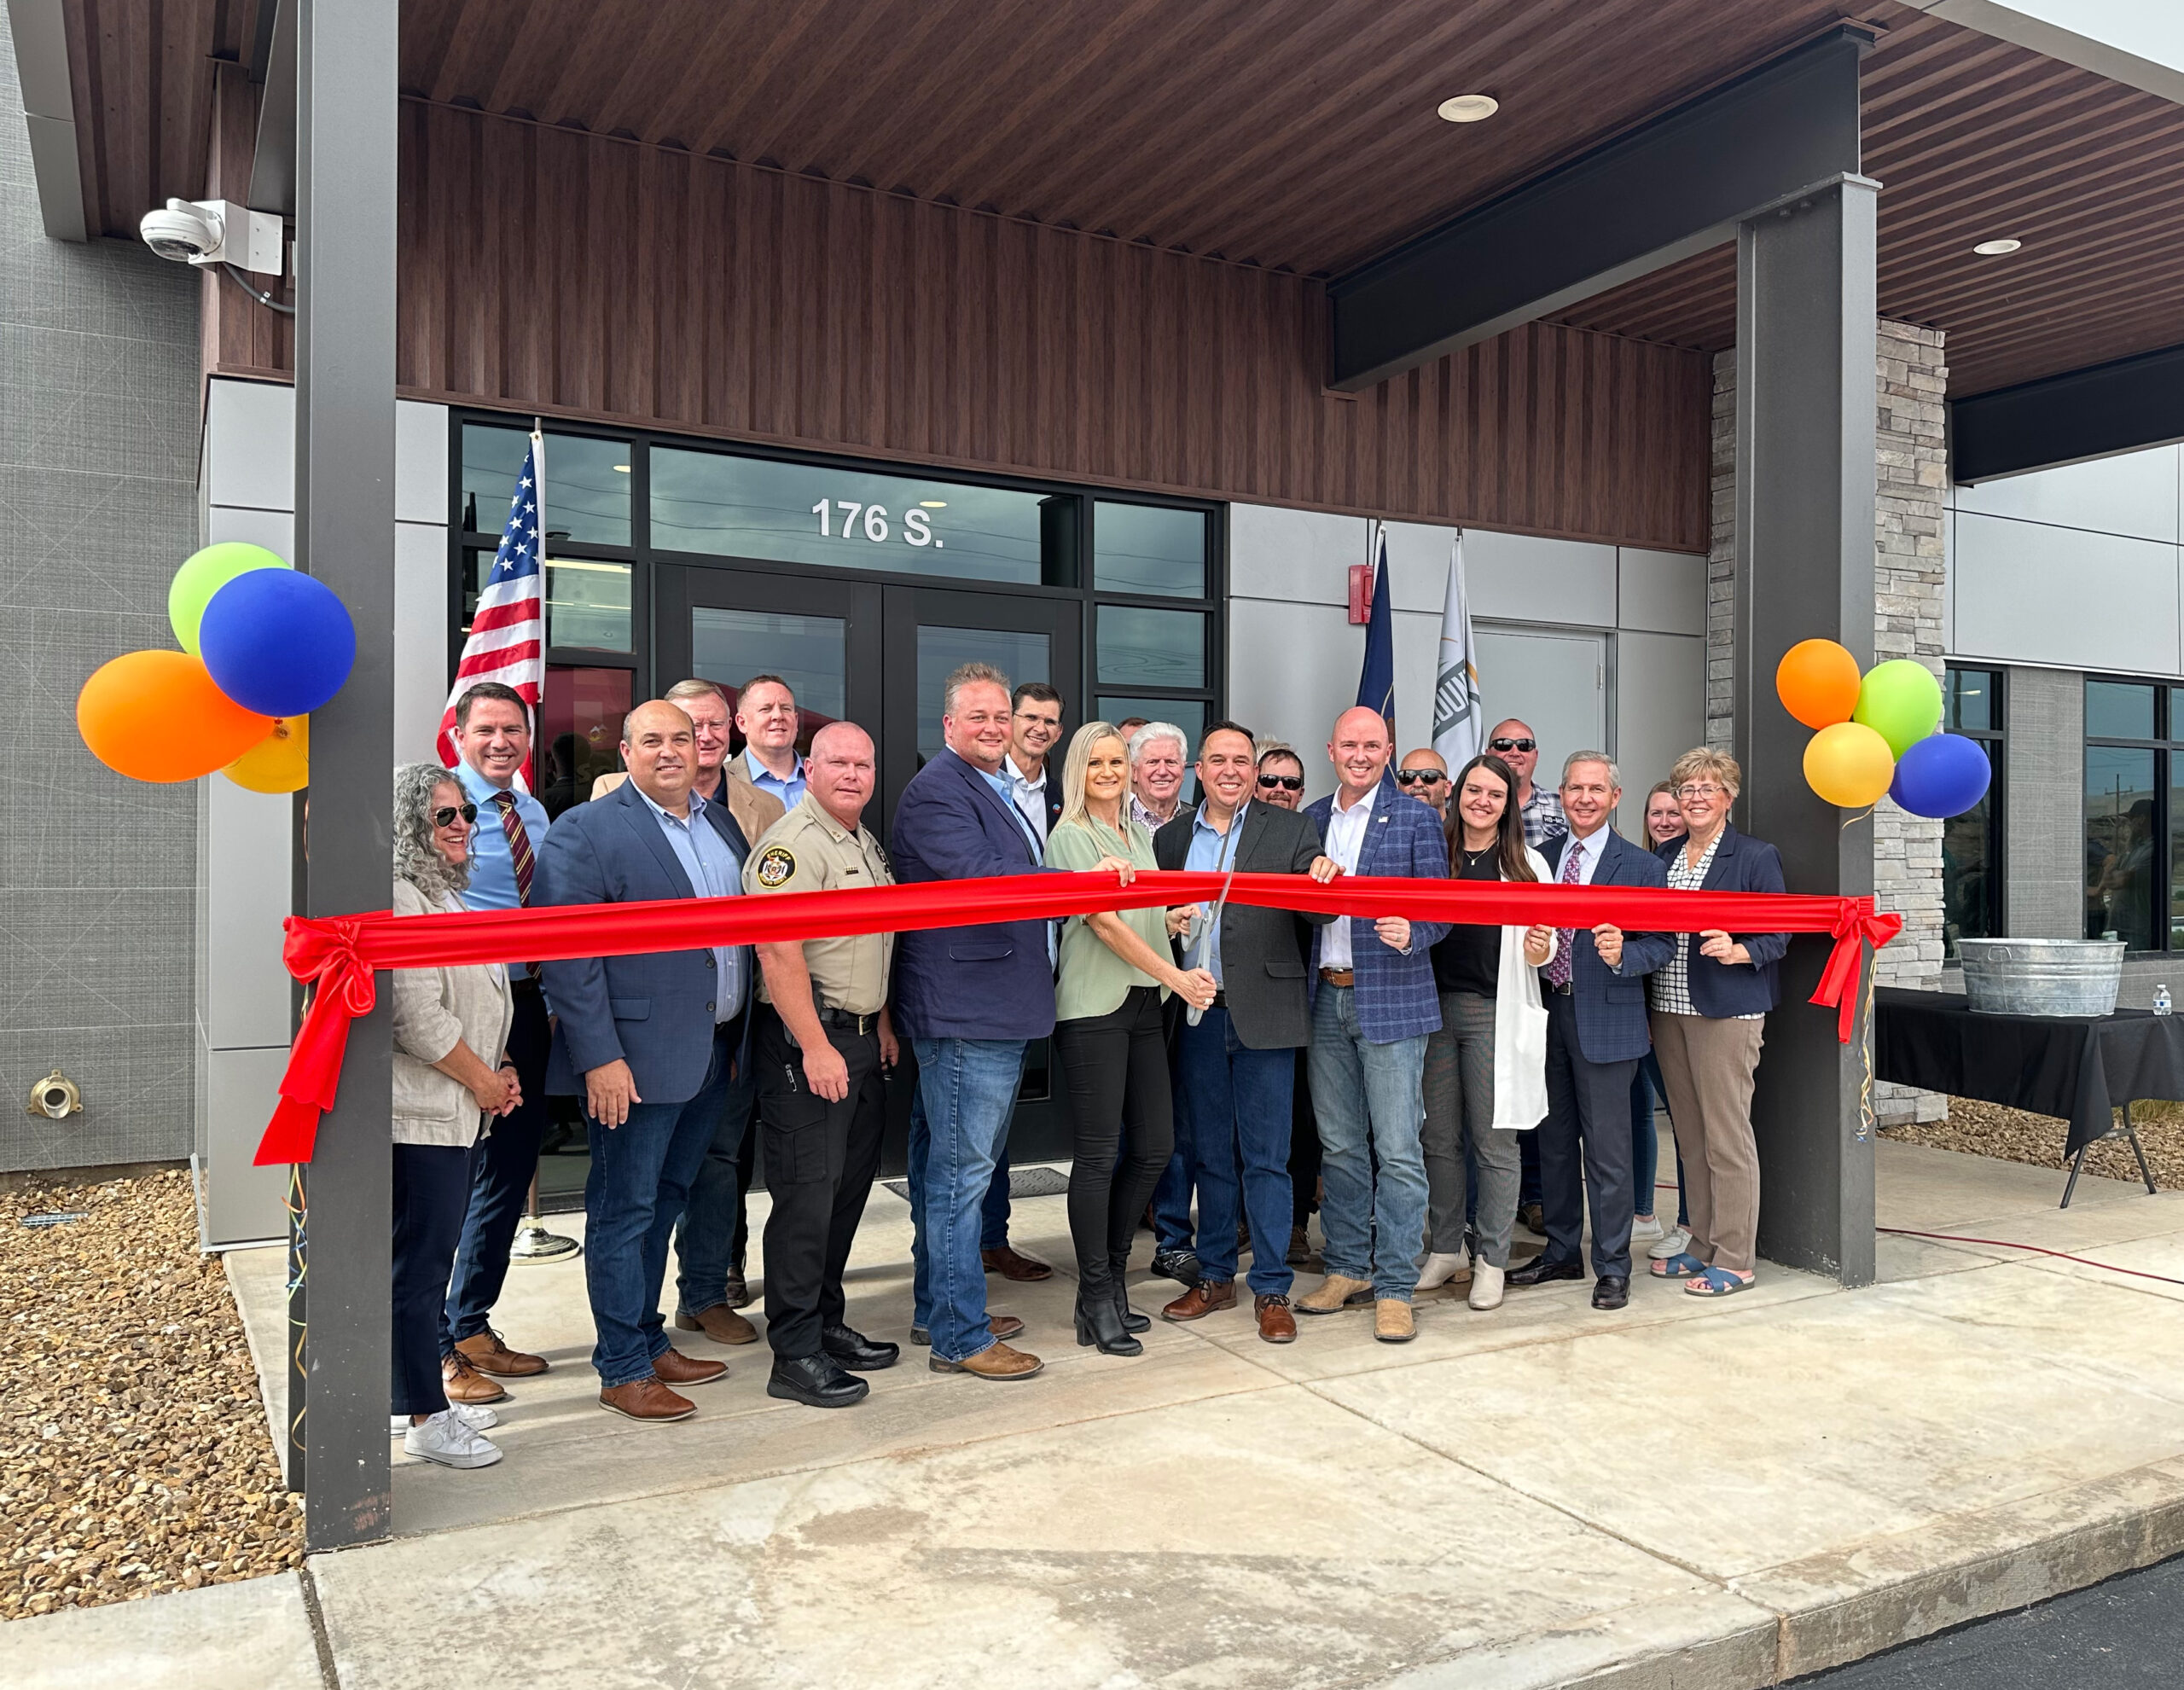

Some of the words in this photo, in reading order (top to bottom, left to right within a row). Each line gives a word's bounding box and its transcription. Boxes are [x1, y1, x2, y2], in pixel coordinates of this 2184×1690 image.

[812, 498, 888, 543] 176
[903, 508, 944, 548] S.
[766, 850, 792, 861] SHERIFF
